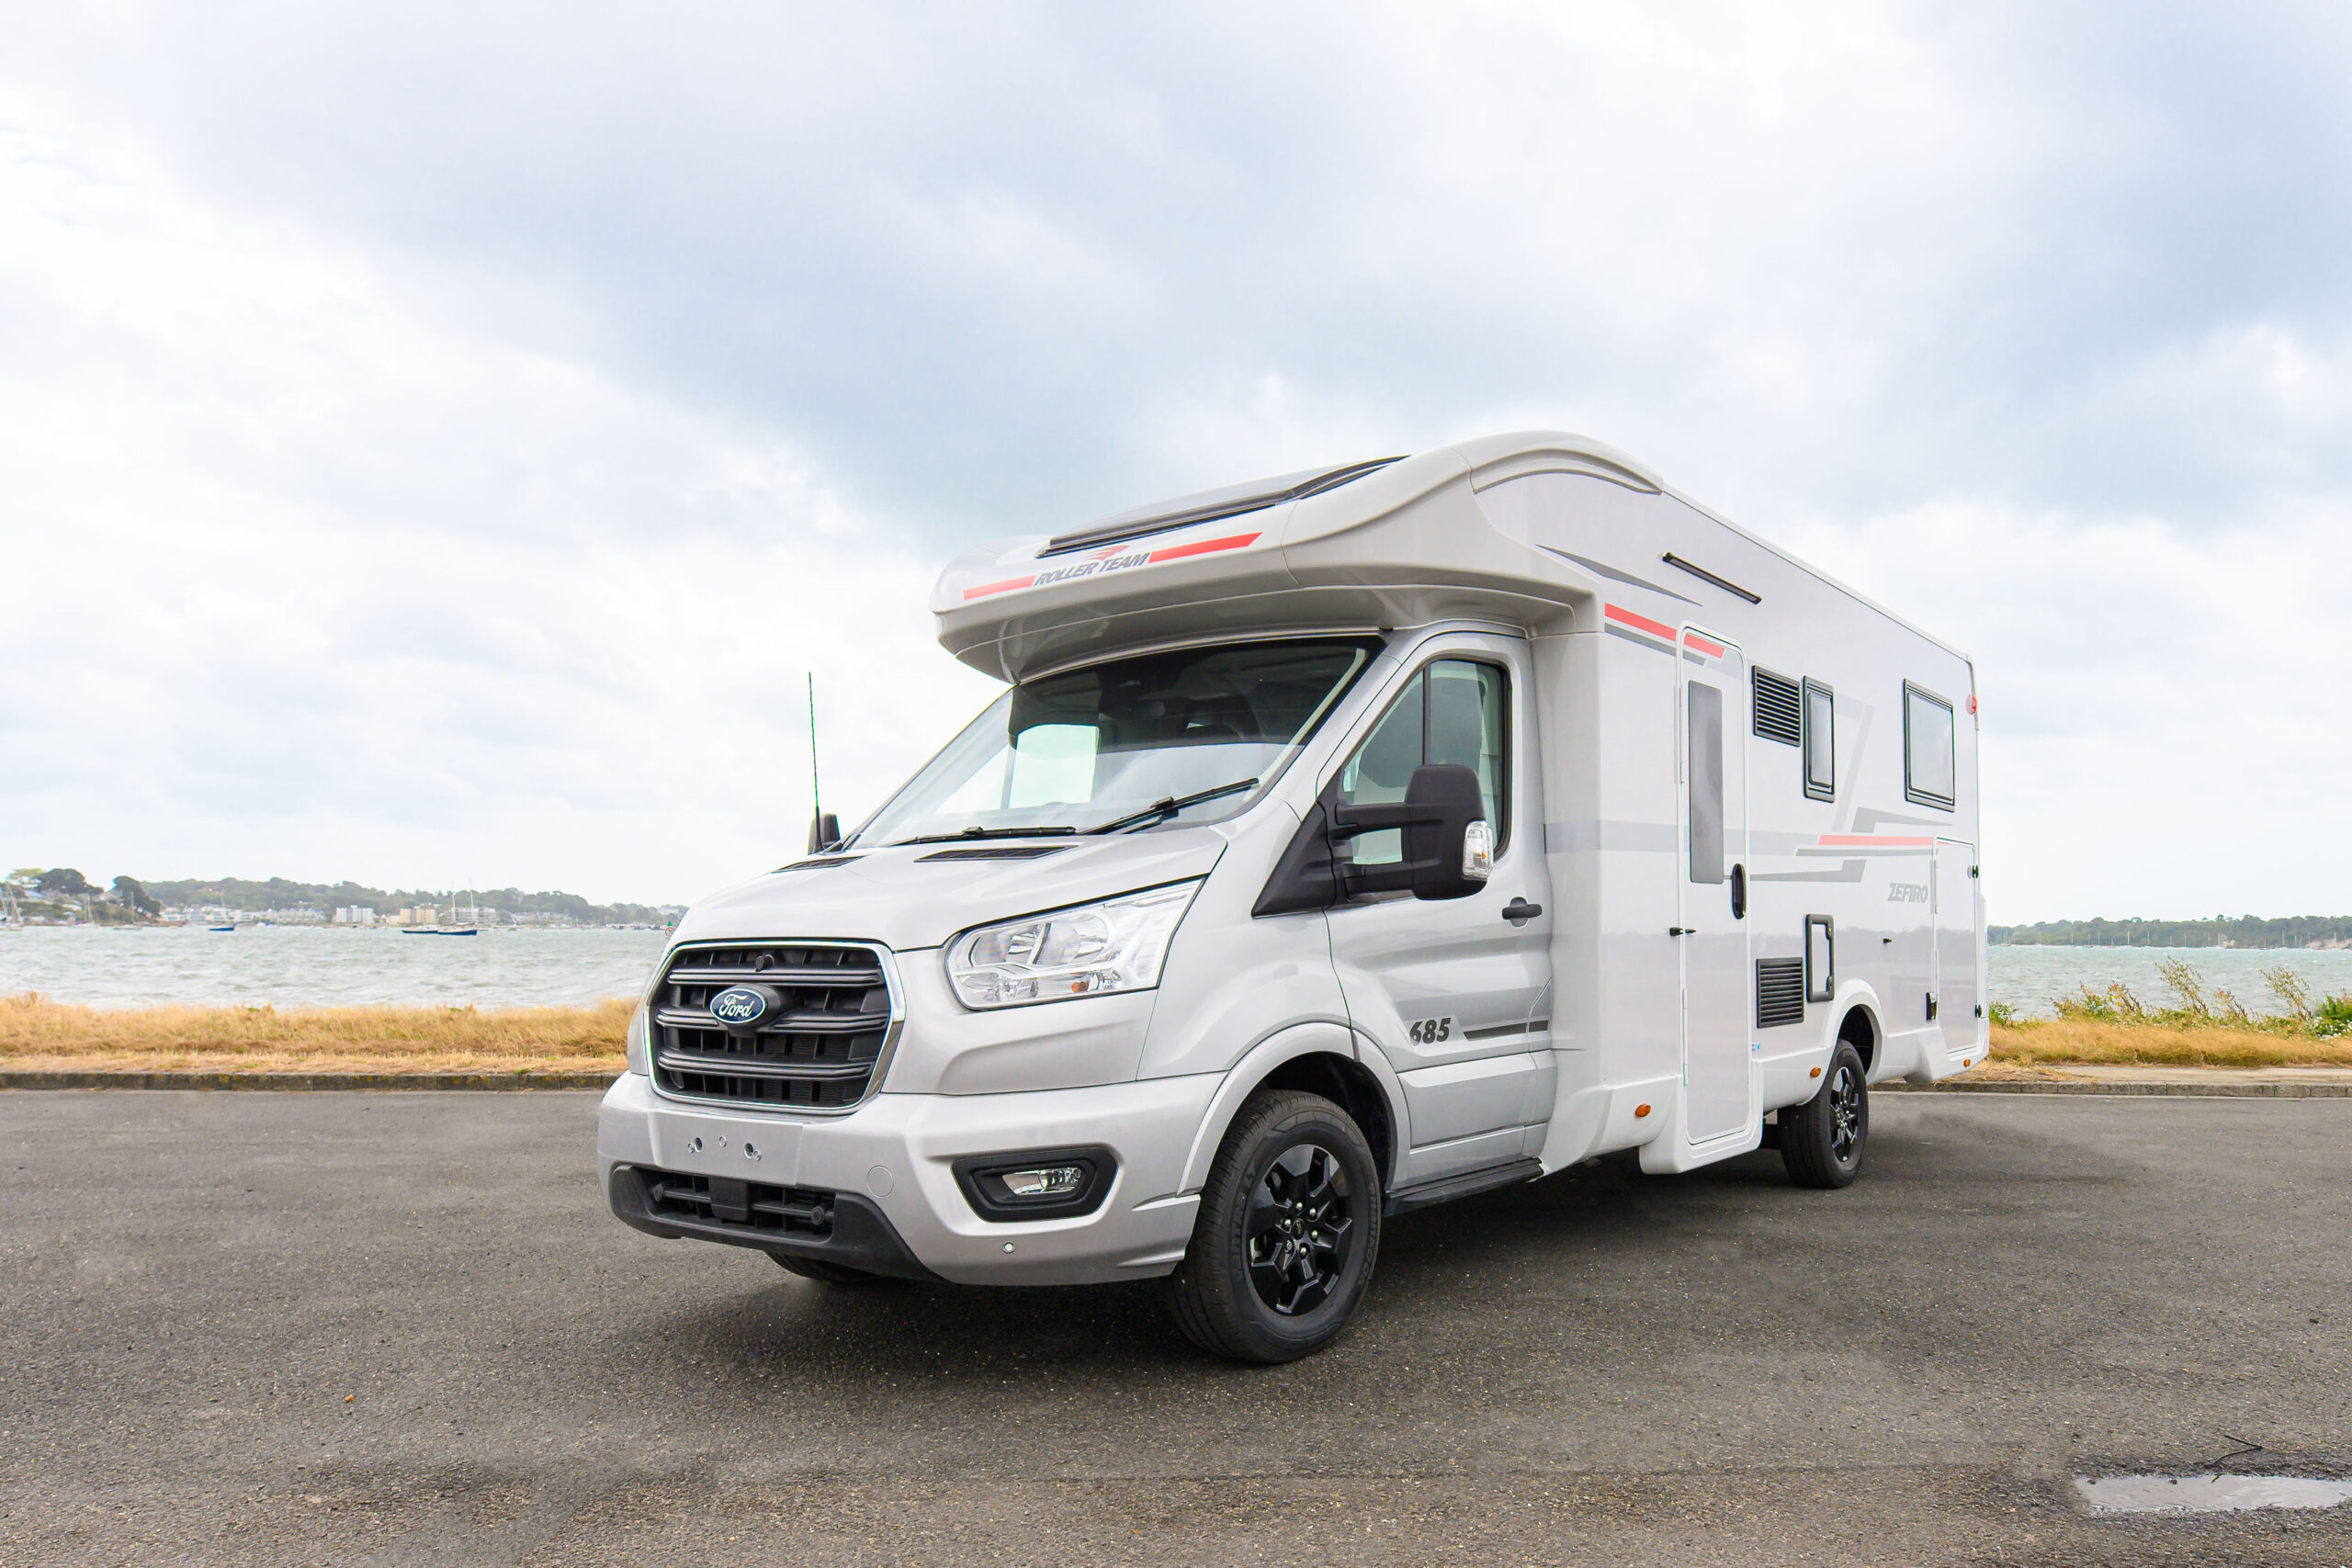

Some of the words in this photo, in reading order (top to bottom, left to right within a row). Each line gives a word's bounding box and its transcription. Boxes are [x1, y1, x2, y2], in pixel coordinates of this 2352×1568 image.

[1034, 562, 1099, 586] ROLLER
[1099, 552, 1150, 572] TEAM
[1887, 883, 1928, 903] ZEFIRO
[718, 993, 755, 1017] Ford
[1409, 1018, 1451, 1045] 685
